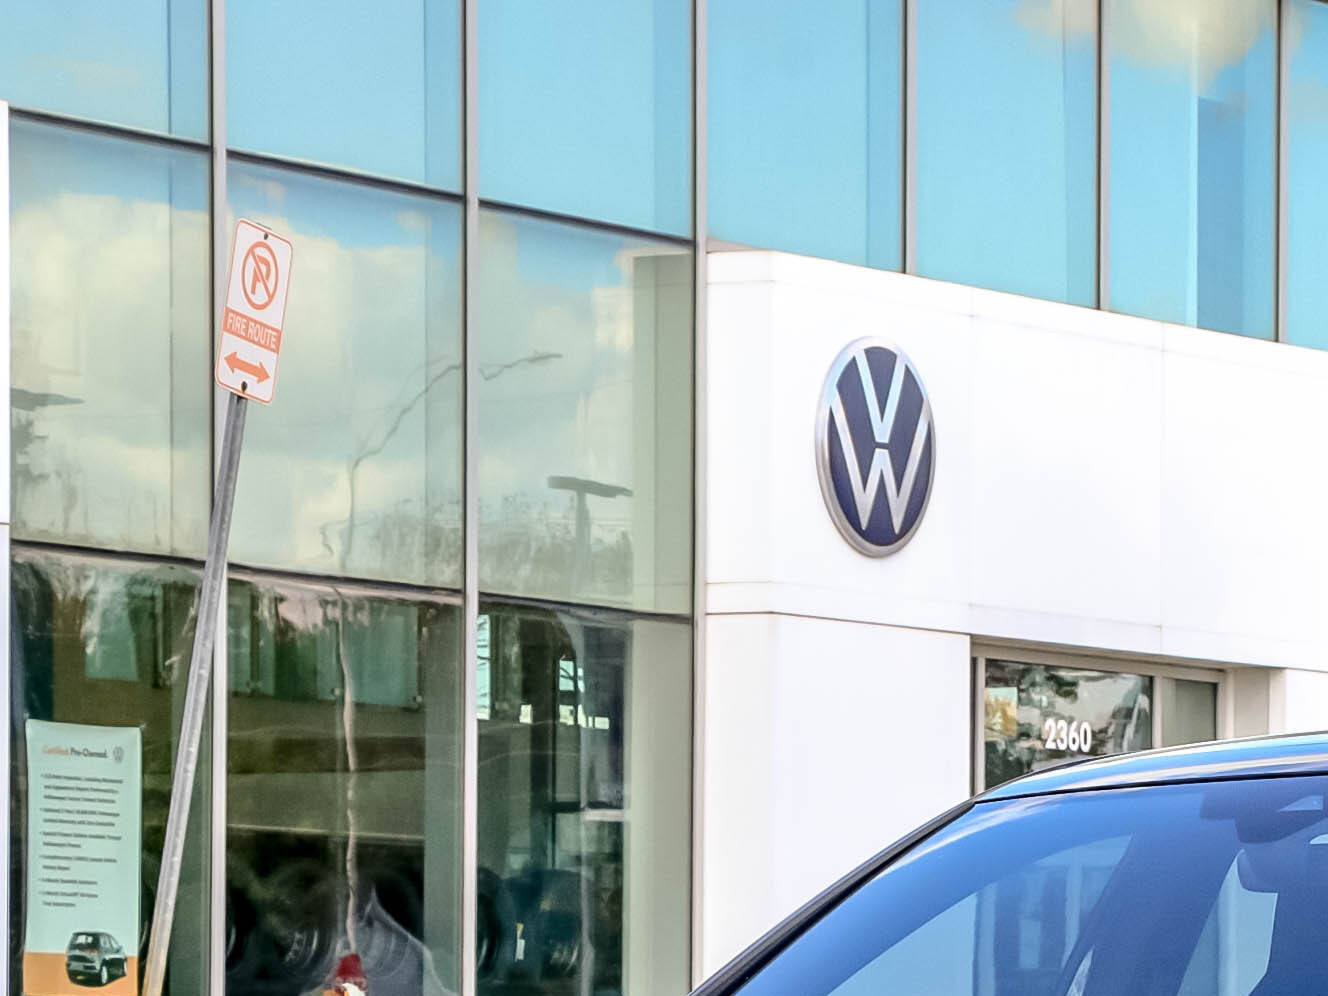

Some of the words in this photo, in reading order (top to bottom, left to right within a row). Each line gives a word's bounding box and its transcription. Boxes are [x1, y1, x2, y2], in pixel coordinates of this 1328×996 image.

[226, 312, 247, 337] FIRE
[247, 320, 278, 349] ROUTE
[1044, 718, 1092, 753] 2360
